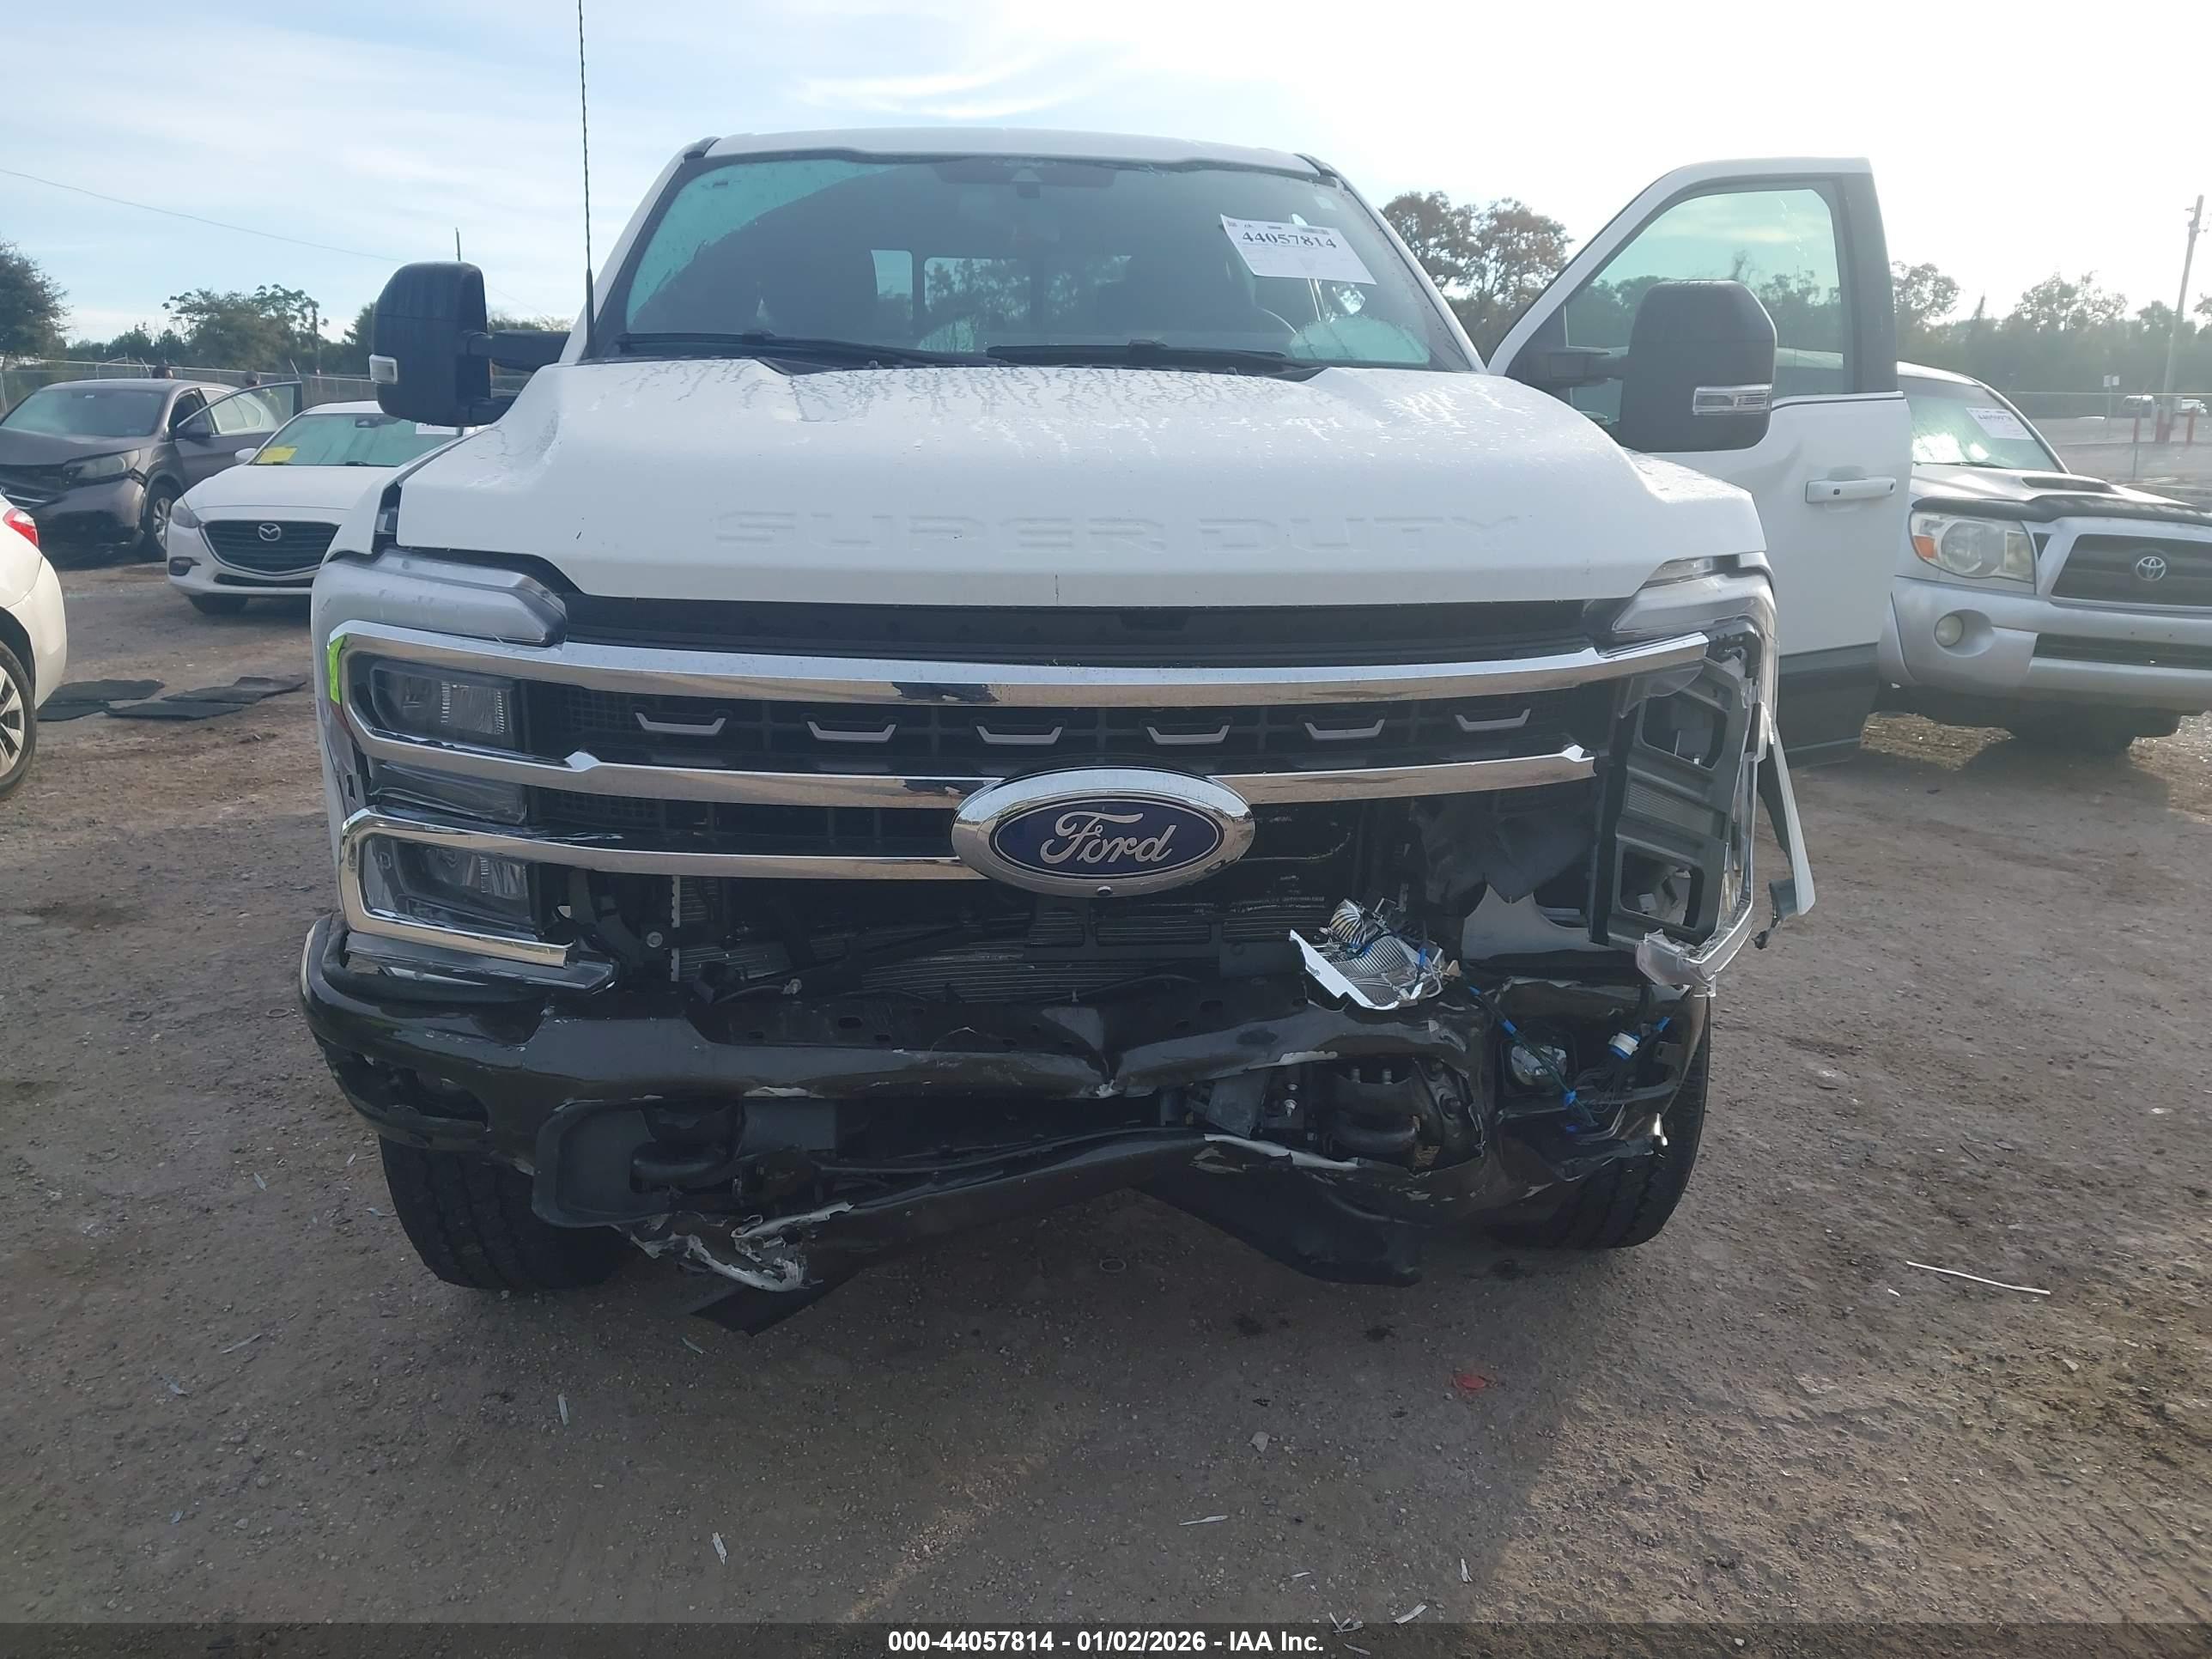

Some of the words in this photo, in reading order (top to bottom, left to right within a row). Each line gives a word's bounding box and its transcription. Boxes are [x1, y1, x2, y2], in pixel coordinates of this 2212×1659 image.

[1242, 231, 1338, 248] 44057814
[714, 511, 1167, 553] SUPER
[1198, 514, 1519, 554] DUTY
[1039, 810, 1177, 866] Ford
